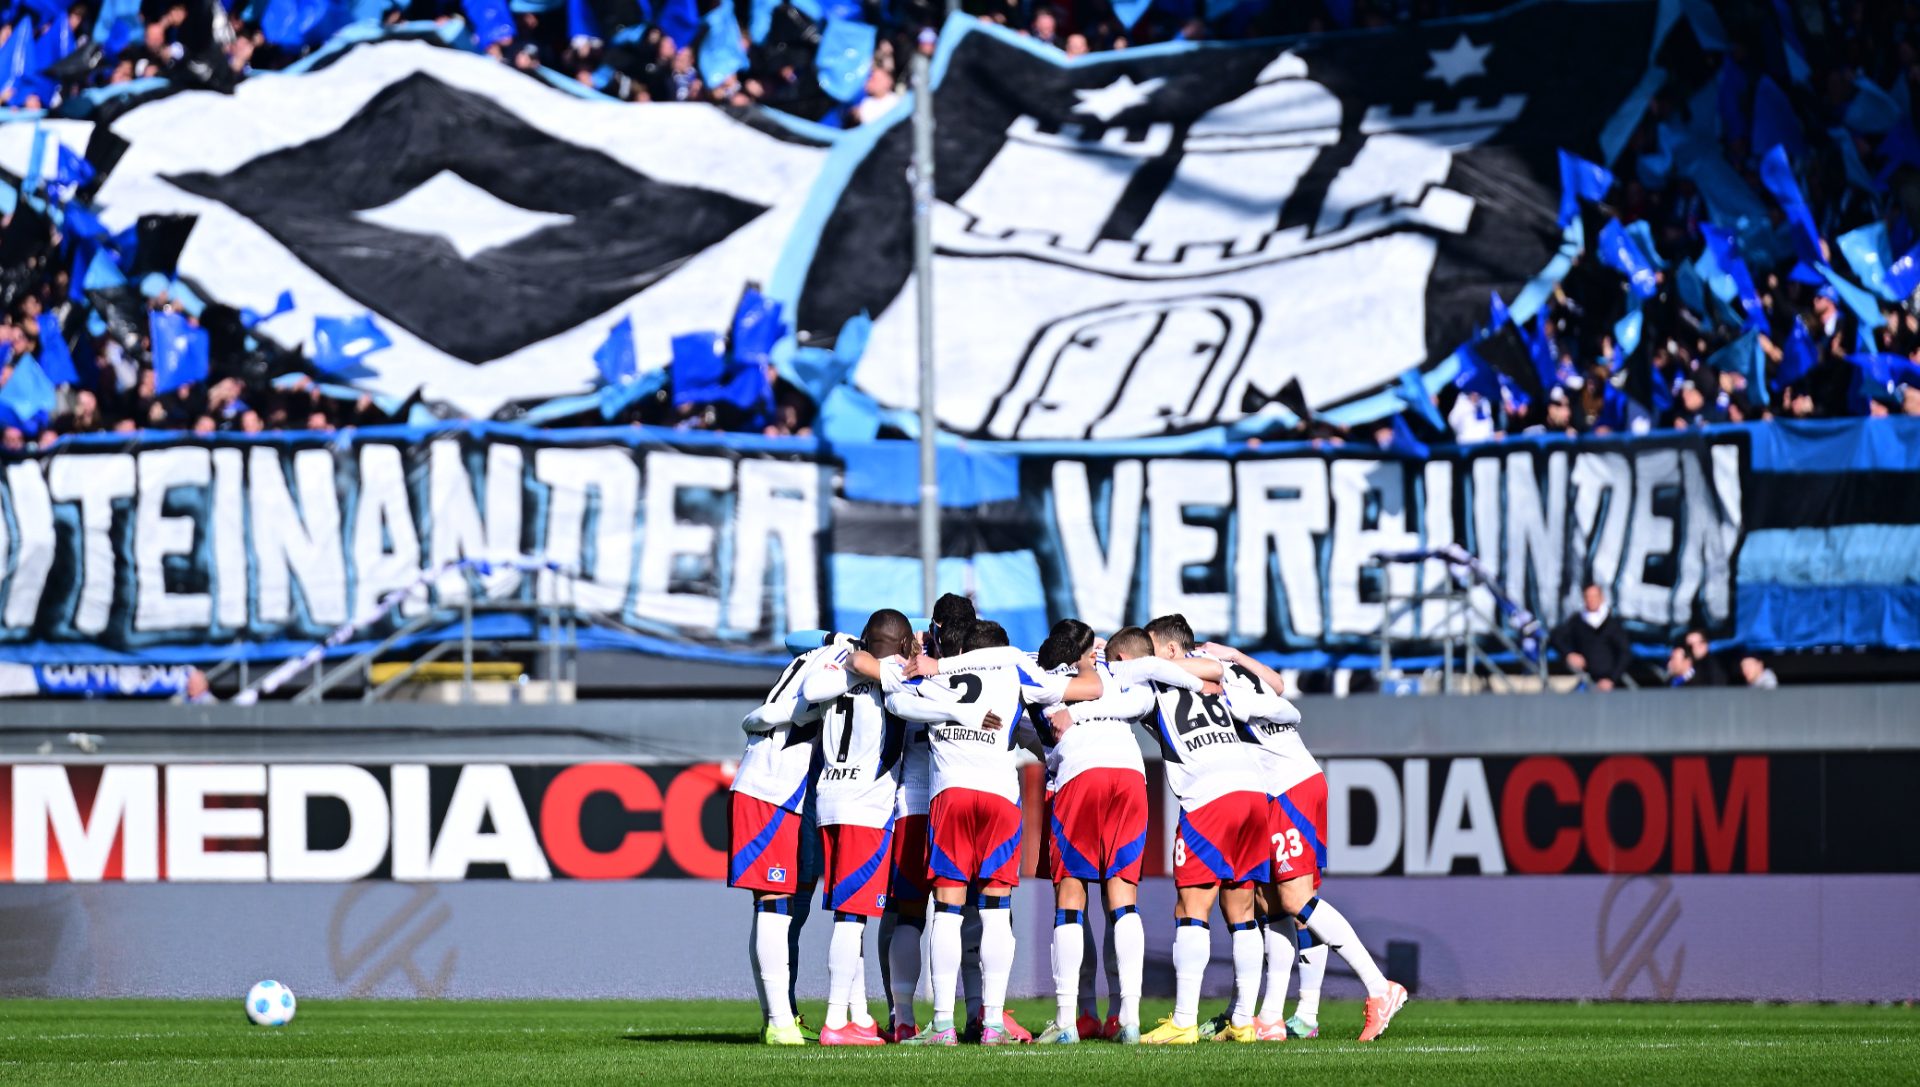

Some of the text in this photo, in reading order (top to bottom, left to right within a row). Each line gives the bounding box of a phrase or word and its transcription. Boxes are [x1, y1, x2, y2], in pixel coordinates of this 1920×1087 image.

[0, 440, 832, 635] ITEINANDER
[946, 673, 983, 727] 2
[12, 763, 730, 881] MEDIACO
[1271, 828, 1304, 862] 23
[1320, 756, 1769, 875] DIACOM
